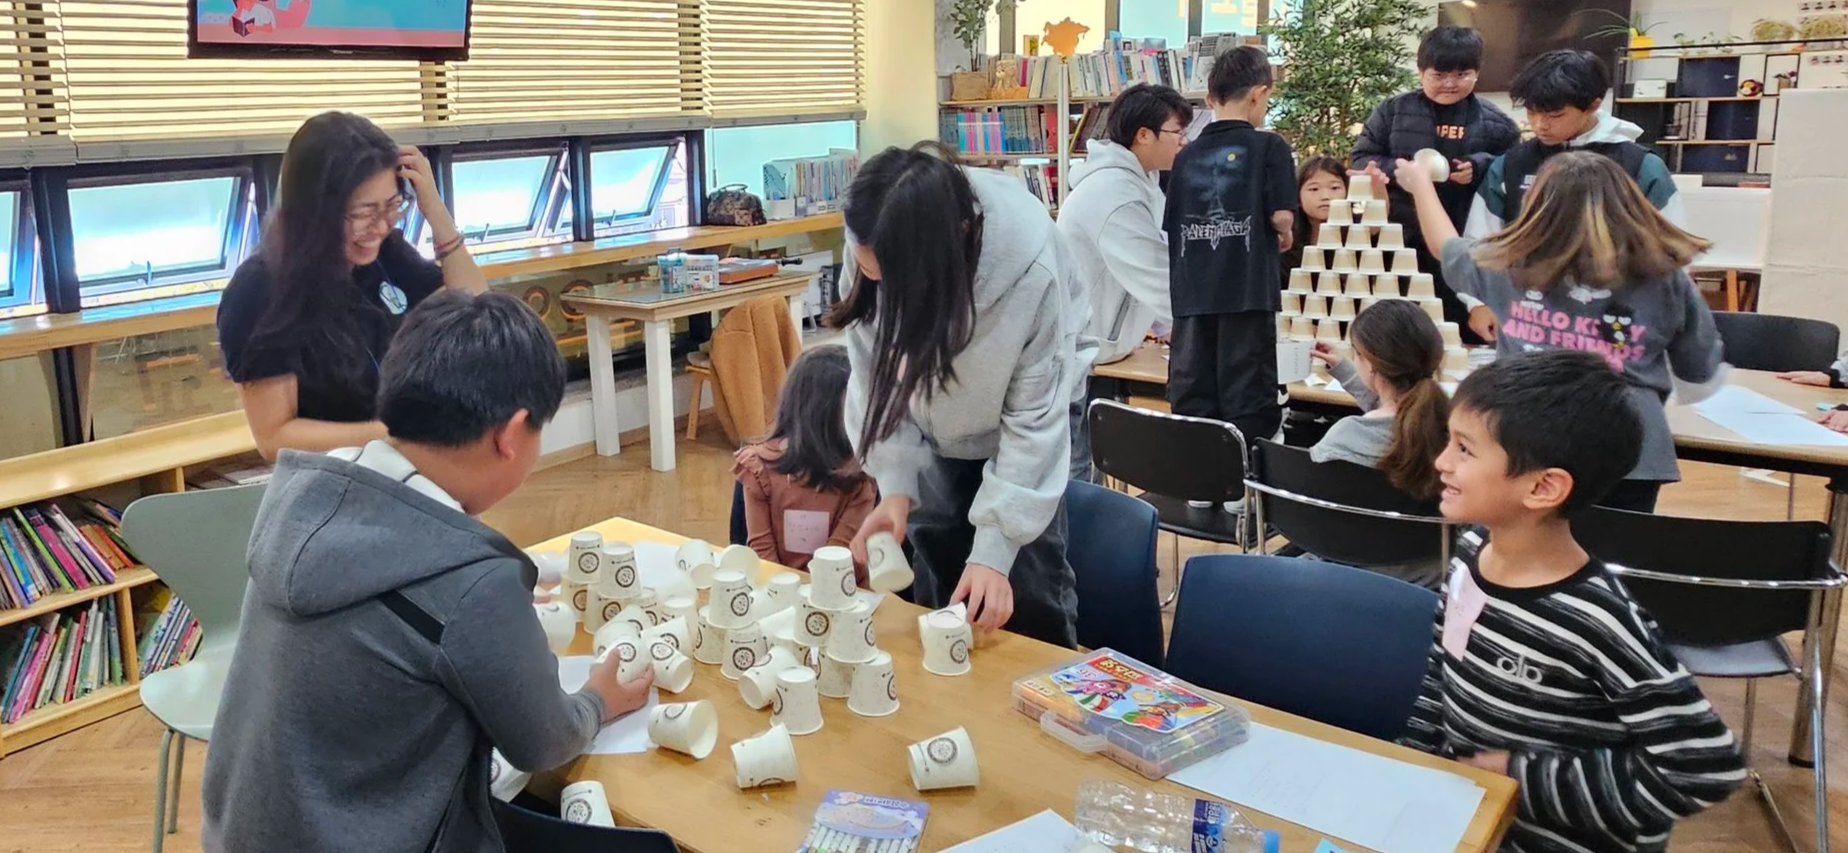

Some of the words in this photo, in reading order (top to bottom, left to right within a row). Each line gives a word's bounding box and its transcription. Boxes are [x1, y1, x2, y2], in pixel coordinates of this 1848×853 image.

[1502, 319, 1546, 343] AND
[1550, 329, 1646, 361] FRIENDS
[1509, 301, 1571, 330] HELLO
[1575, 316, 1647, 342] KIY
